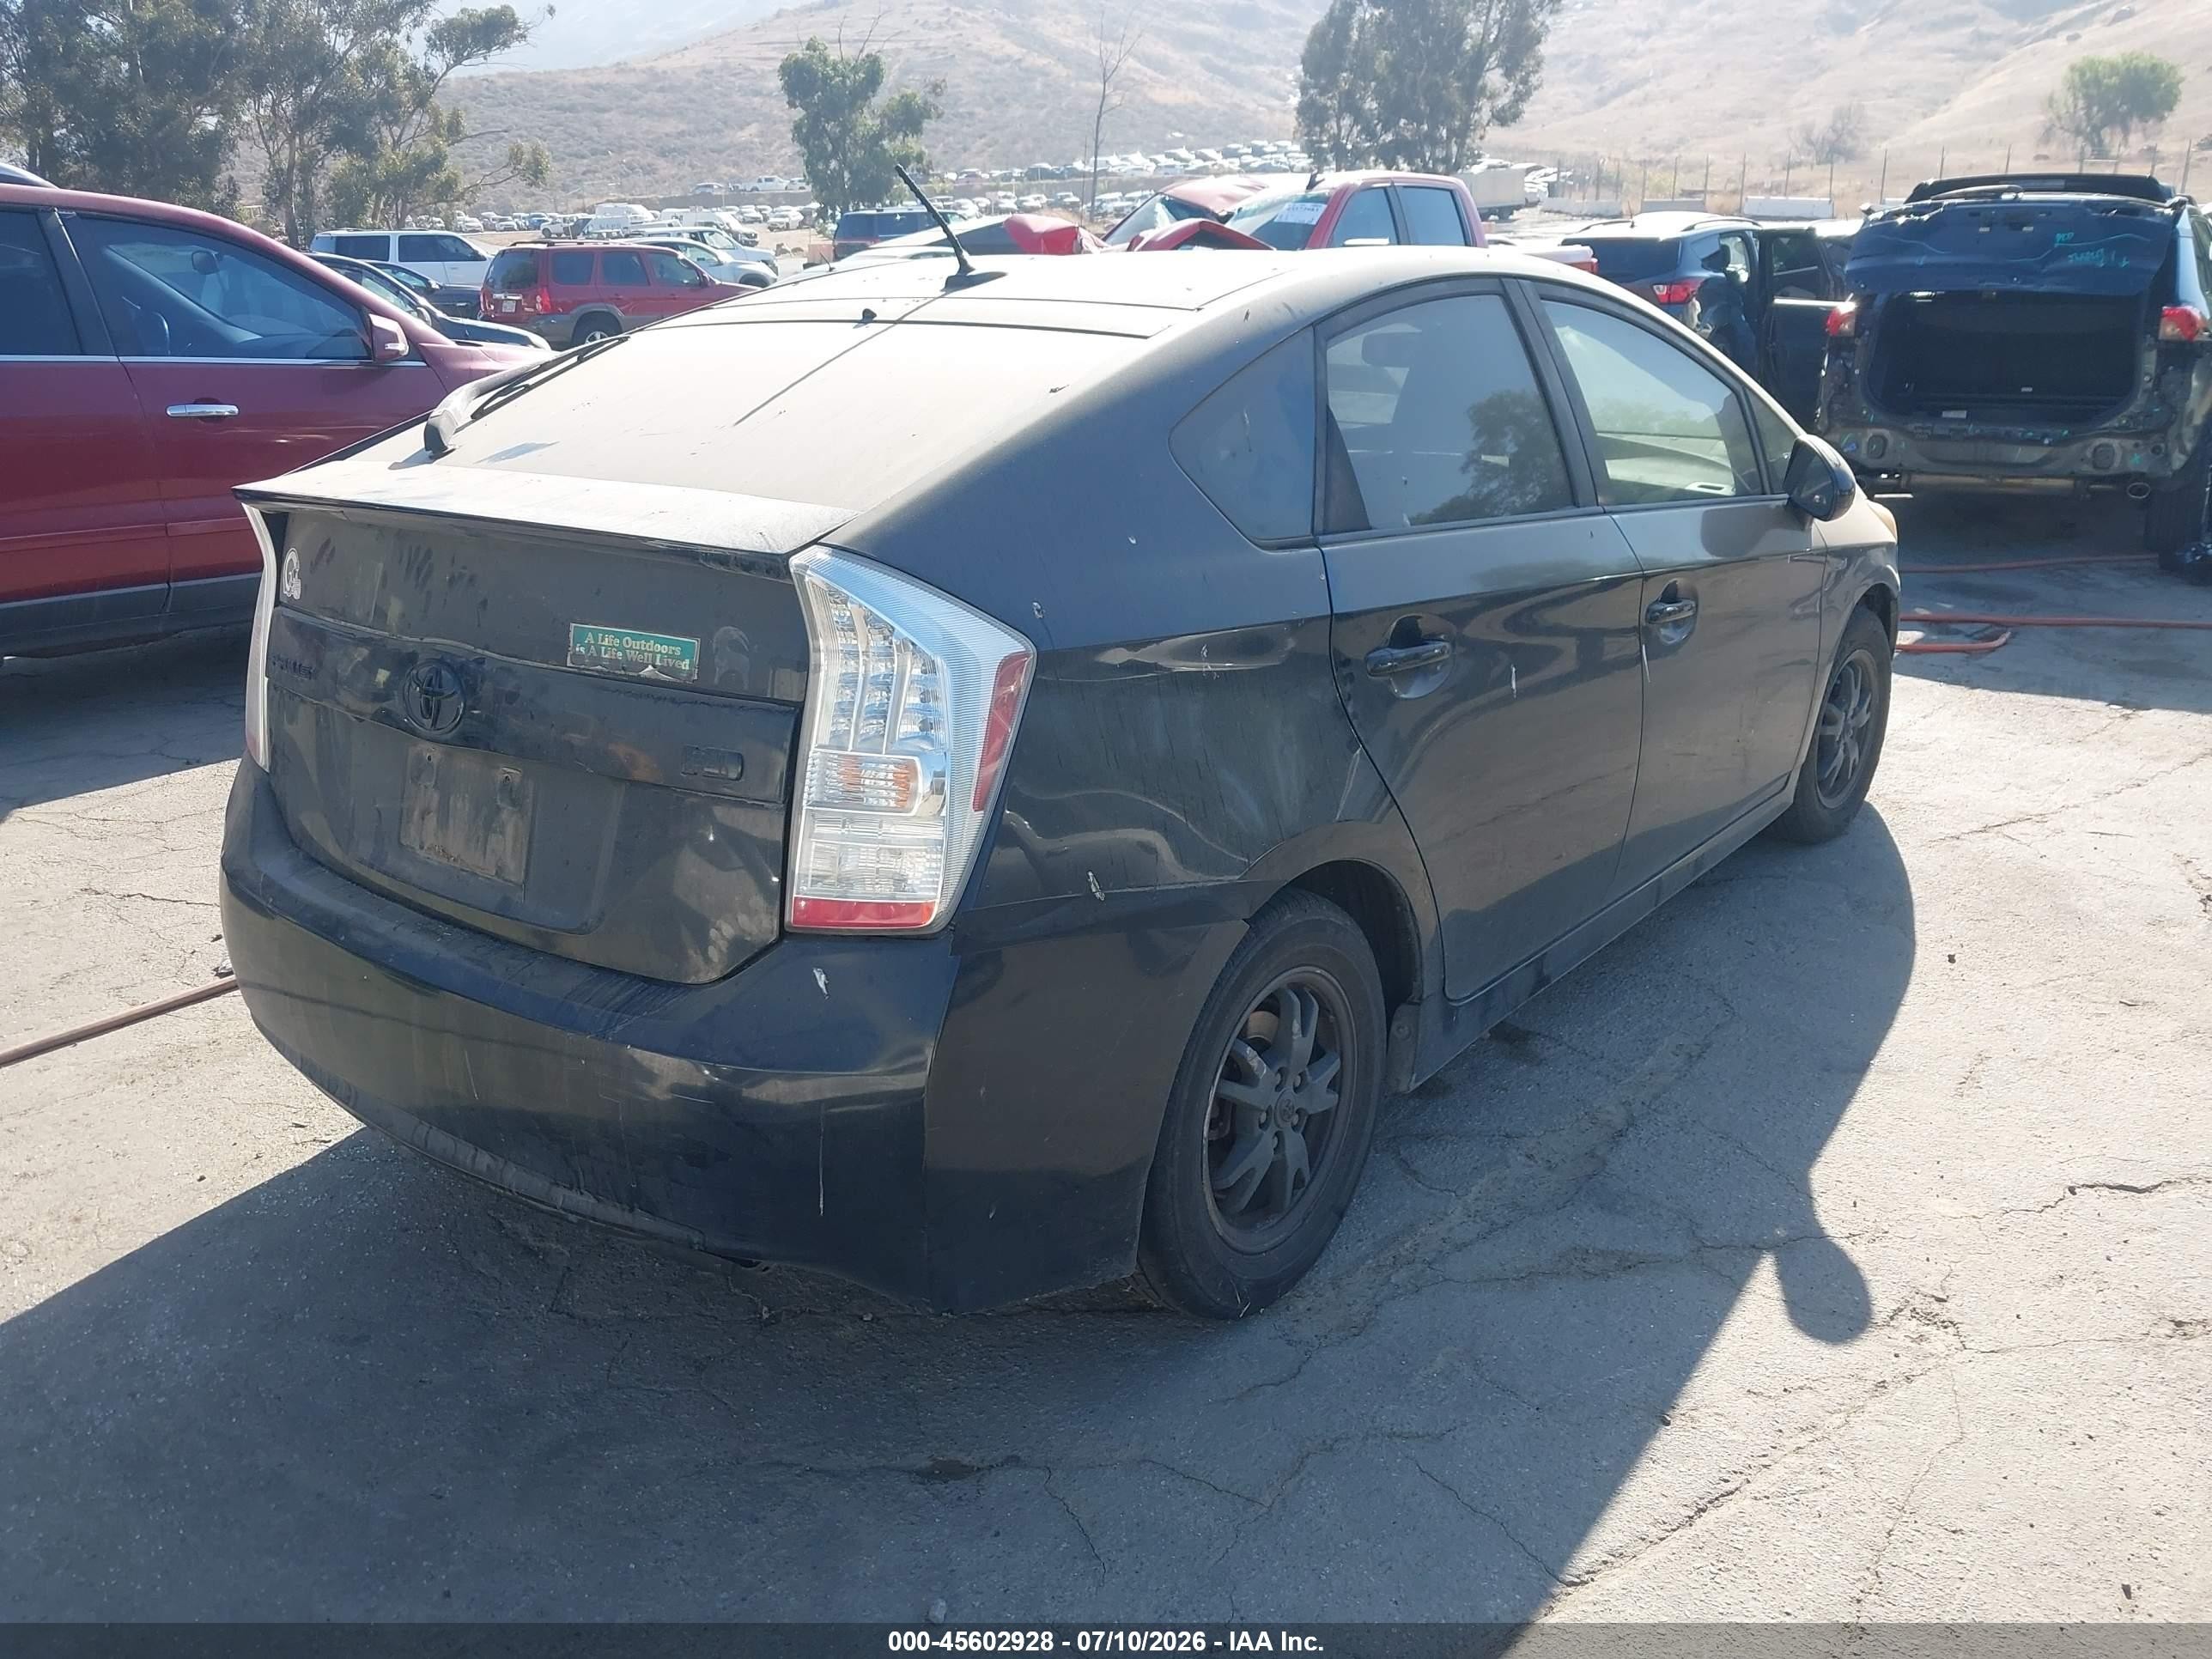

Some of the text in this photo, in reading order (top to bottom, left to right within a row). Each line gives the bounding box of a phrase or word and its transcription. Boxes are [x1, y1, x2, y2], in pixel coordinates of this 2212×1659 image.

[585, 632, 682, 655] A Life Outdoors
[587, 646, 598, 656] A
[601, 647, 623, 659] Life
[625, 649, 653, 664] Well
[655, 653, 690, 670] Lived
